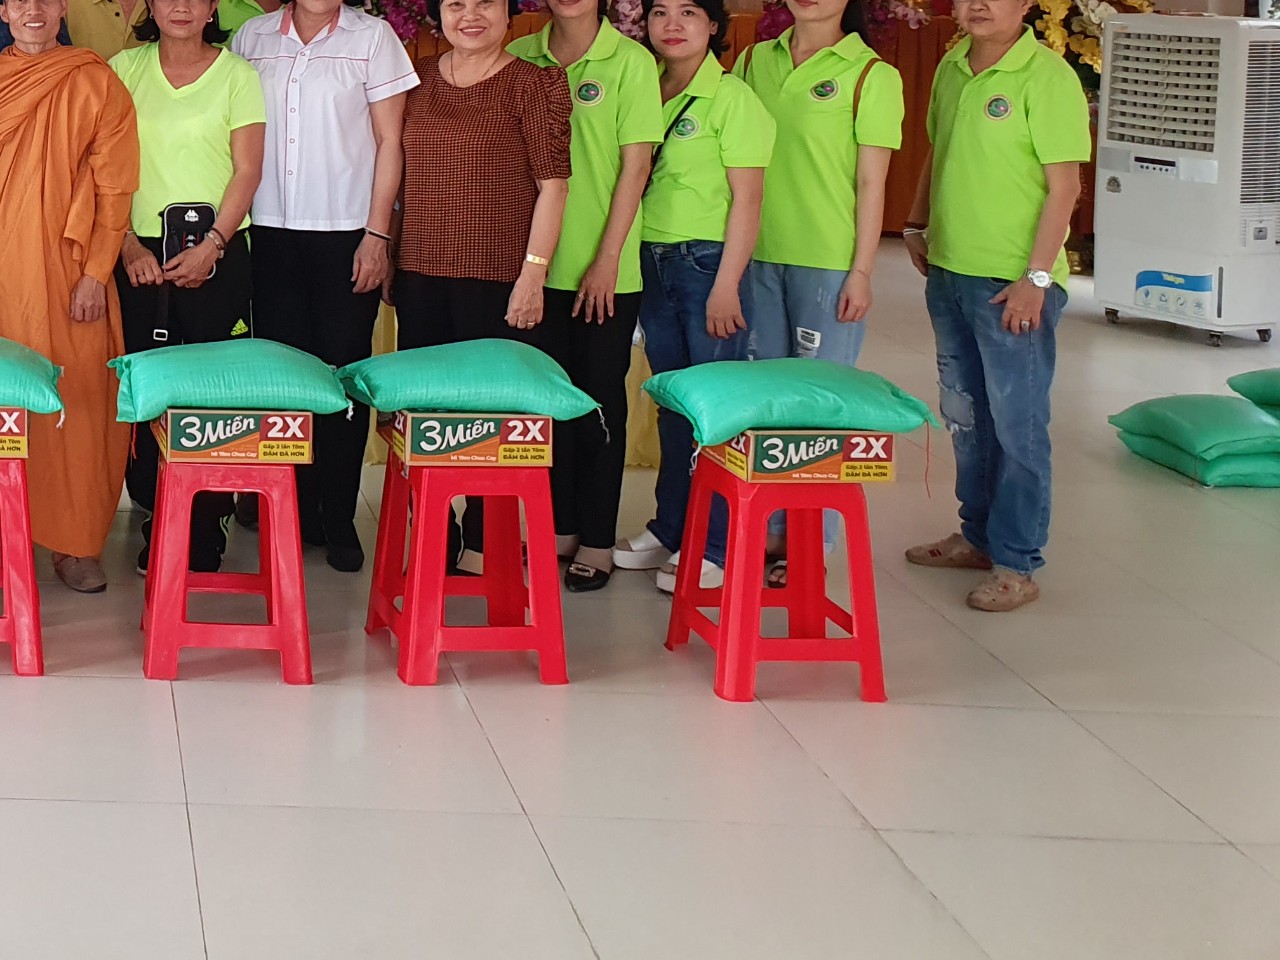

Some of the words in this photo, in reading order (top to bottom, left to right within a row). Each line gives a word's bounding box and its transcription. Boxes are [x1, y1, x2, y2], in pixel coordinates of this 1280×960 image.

[267, 416, 305, 438] 2X
[507, 420, 545, 442] 2X
[850, 436, 888, 459] 2X
